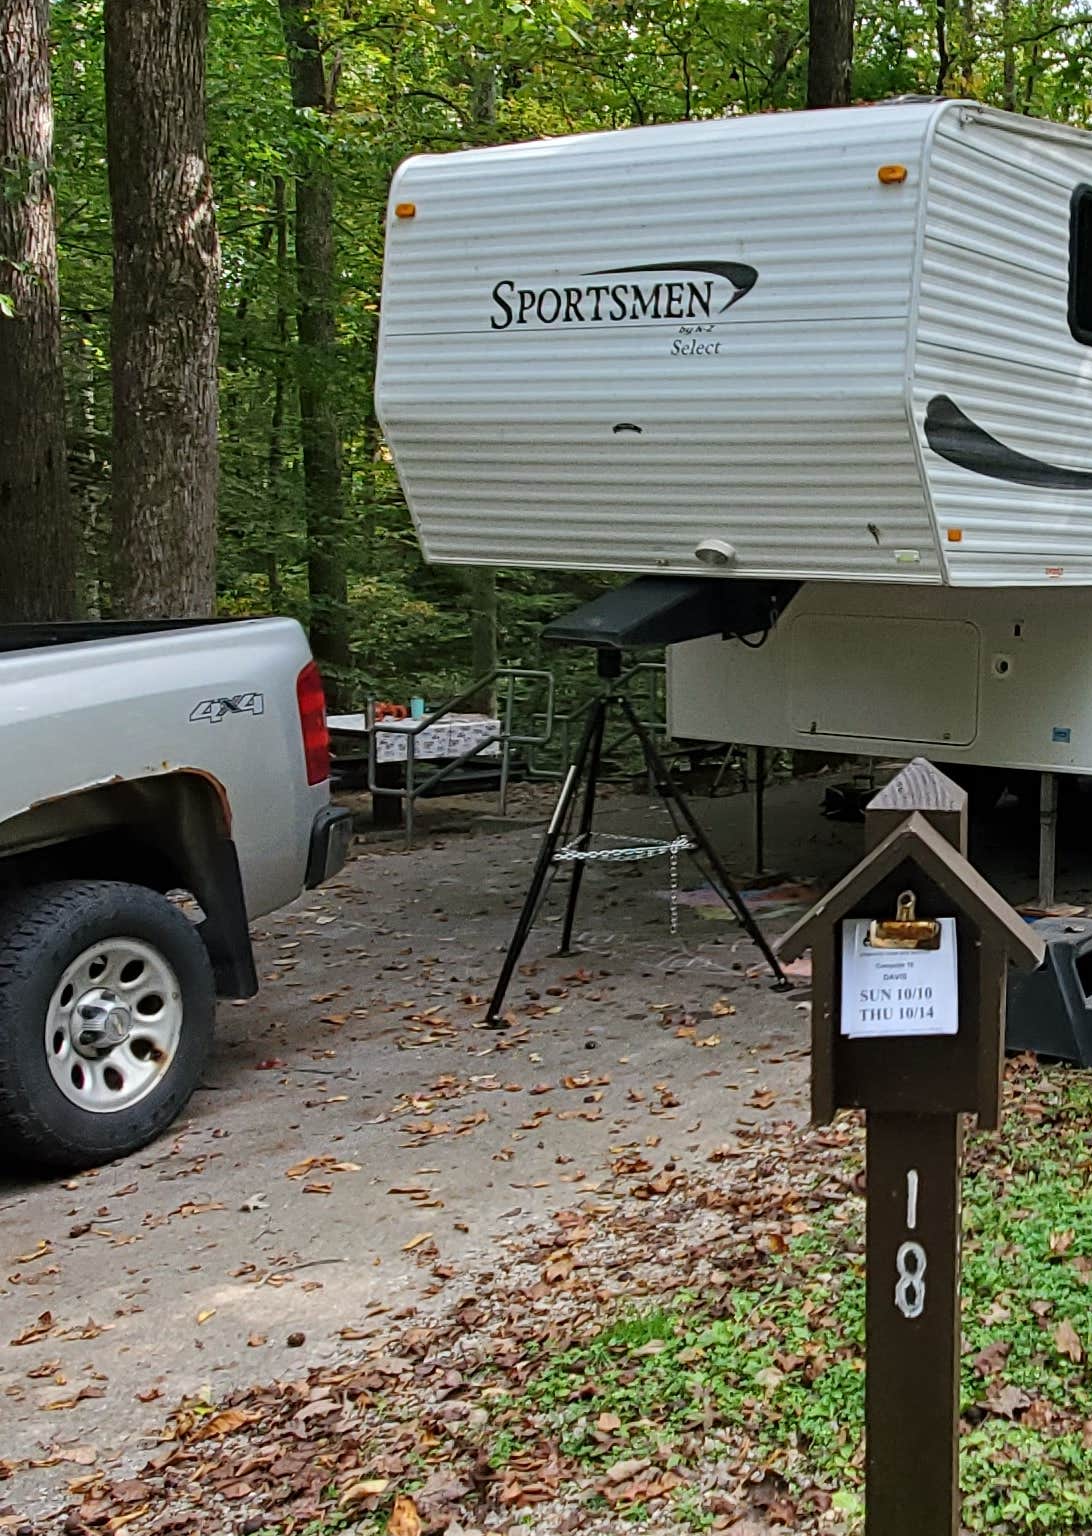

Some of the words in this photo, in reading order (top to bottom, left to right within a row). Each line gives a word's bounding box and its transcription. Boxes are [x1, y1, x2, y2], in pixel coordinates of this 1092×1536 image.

[490, 280, 714, 330] SPORTSMEN
[671, 338, 721, 355] Select
[860, 989, 892, 1001] SUN
[897, 987, 933, 1000] 10/10
[860, 1008, 893, 1021] THU
[899, 1006, 934, 1019] 10/14
[895, 1169, 927, 1318] 18
